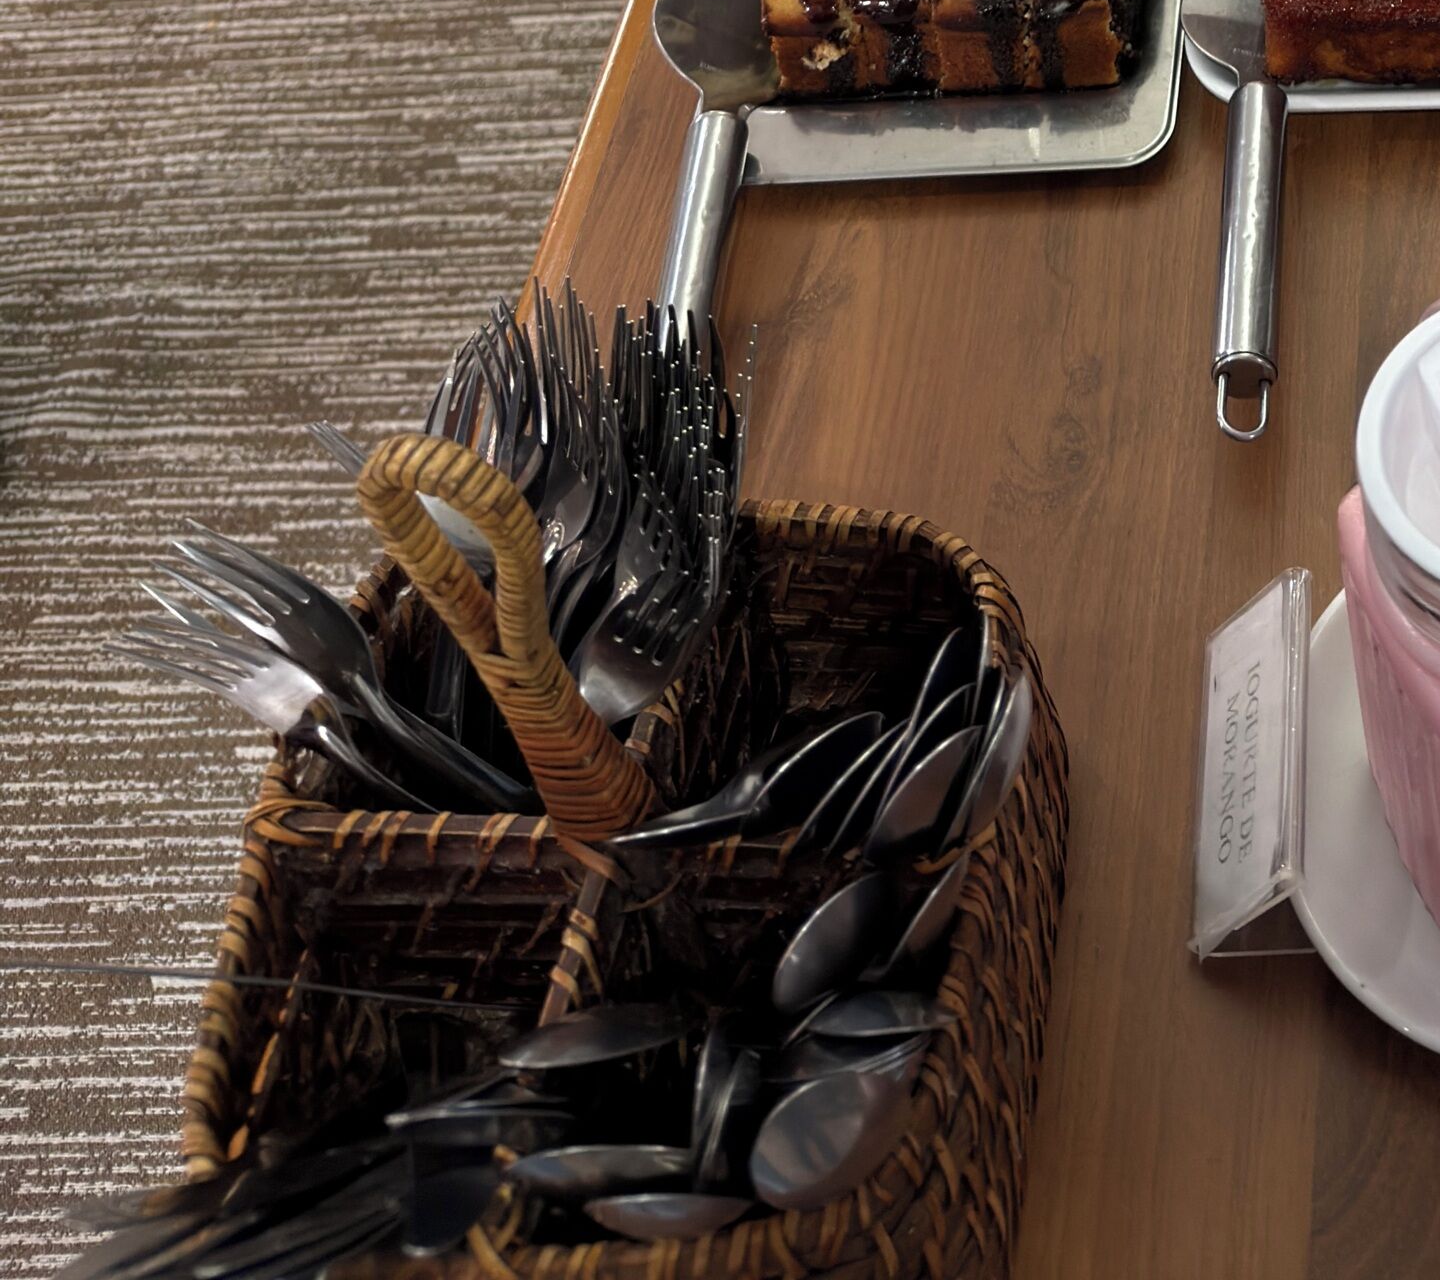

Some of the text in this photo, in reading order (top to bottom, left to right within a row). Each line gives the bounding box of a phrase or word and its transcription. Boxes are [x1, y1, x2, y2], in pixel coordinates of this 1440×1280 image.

[1218, 690, 1240, 864] MORANGO
[1238, 661, 1260, 864] IOGURTE DE
